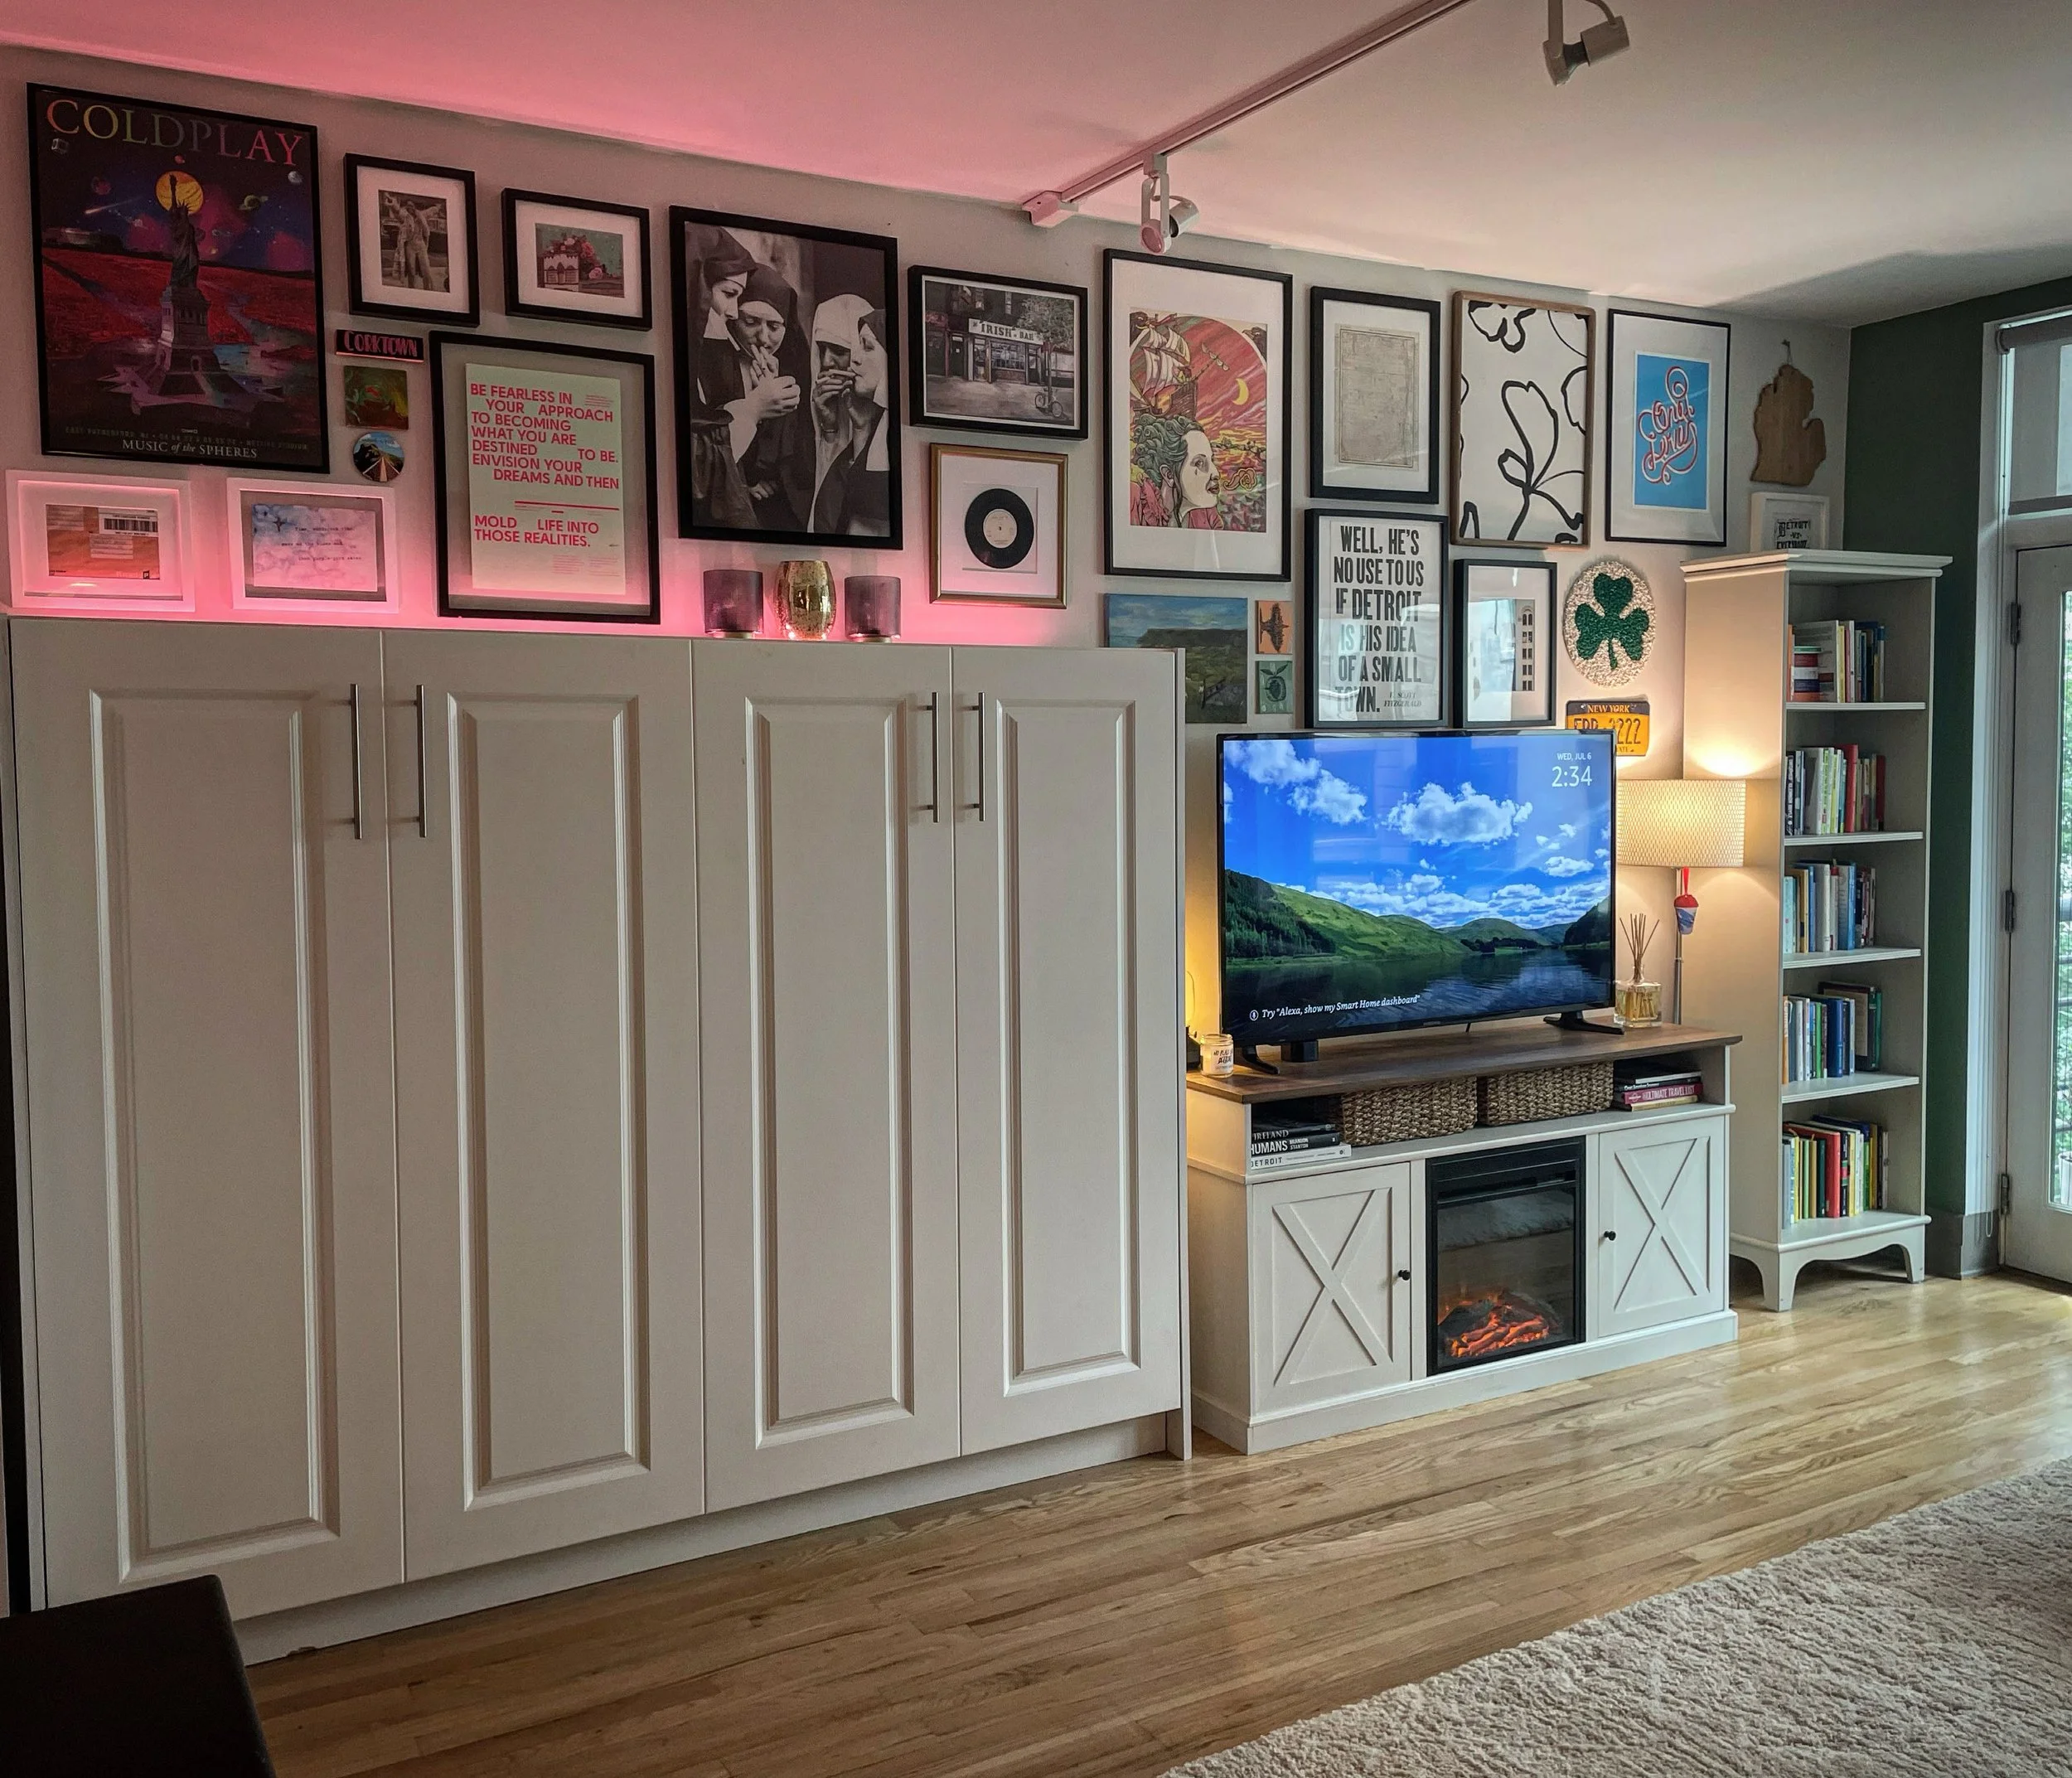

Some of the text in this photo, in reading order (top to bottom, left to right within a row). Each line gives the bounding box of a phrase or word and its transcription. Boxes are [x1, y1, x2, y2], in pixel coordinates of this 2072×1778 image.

[46, 99, 303, 166] COLDPLAY
[981, 323, 1011, 337] IRISH
[343, 330, 418, 357] CORKTOWN
[471, 383, 487, 395] BE
[491, 385, 554, 403] FEARLESS
[559, 392, 572, 405] IN
[472, 411, 571, 431] TO BECOMING
[486, 399, 613, 422] YOUR APPROACH
[472, 425, 577, 446] WHAT YOU ARE
[122, 439, 168, 452] MUSIC
[171, 443, 182, 453] of
[199, 444, 258, 458] SPHERES
[472, 439, 618, 463] DESTINED TO BE.
[472, 453, 583, 473] ENVISION YOUR
[493, 468, 619, 489] DREAMS AND THEN
[474, 515, 599, 534] MOLD LIFE INTO
[474, 529, 590, 547] THOSE REALITIES.
[1340, 525, 1420, 555] WELL, HE'S
[1334, 556, 1424, 587] NO USE TO US
[1335, 588, 1422, 622] IF DETROIT
[1340, 624, 1416, 652] IS HIS IDEA
[1339, 655, 1421, 682] OF A SMALL
[1334, 686, 1381, 713] TOWN.
[1587, 704, 1630, 713] NEW YORK
[1557, 753, 1573, 761] WED,
[1586, 752, 1592, 760] 6
[1552, 765, 1592, 787] 2:34
[1261, 995, 1421, 1020] Try "Alexa, show my Smart Home dashboard"
[1668, 1086, 1685, 1097] TRAVEL
[1685, 1085, 1695, 1095] LIST
[1254, 1129, 1289, 1141] IRELAND
